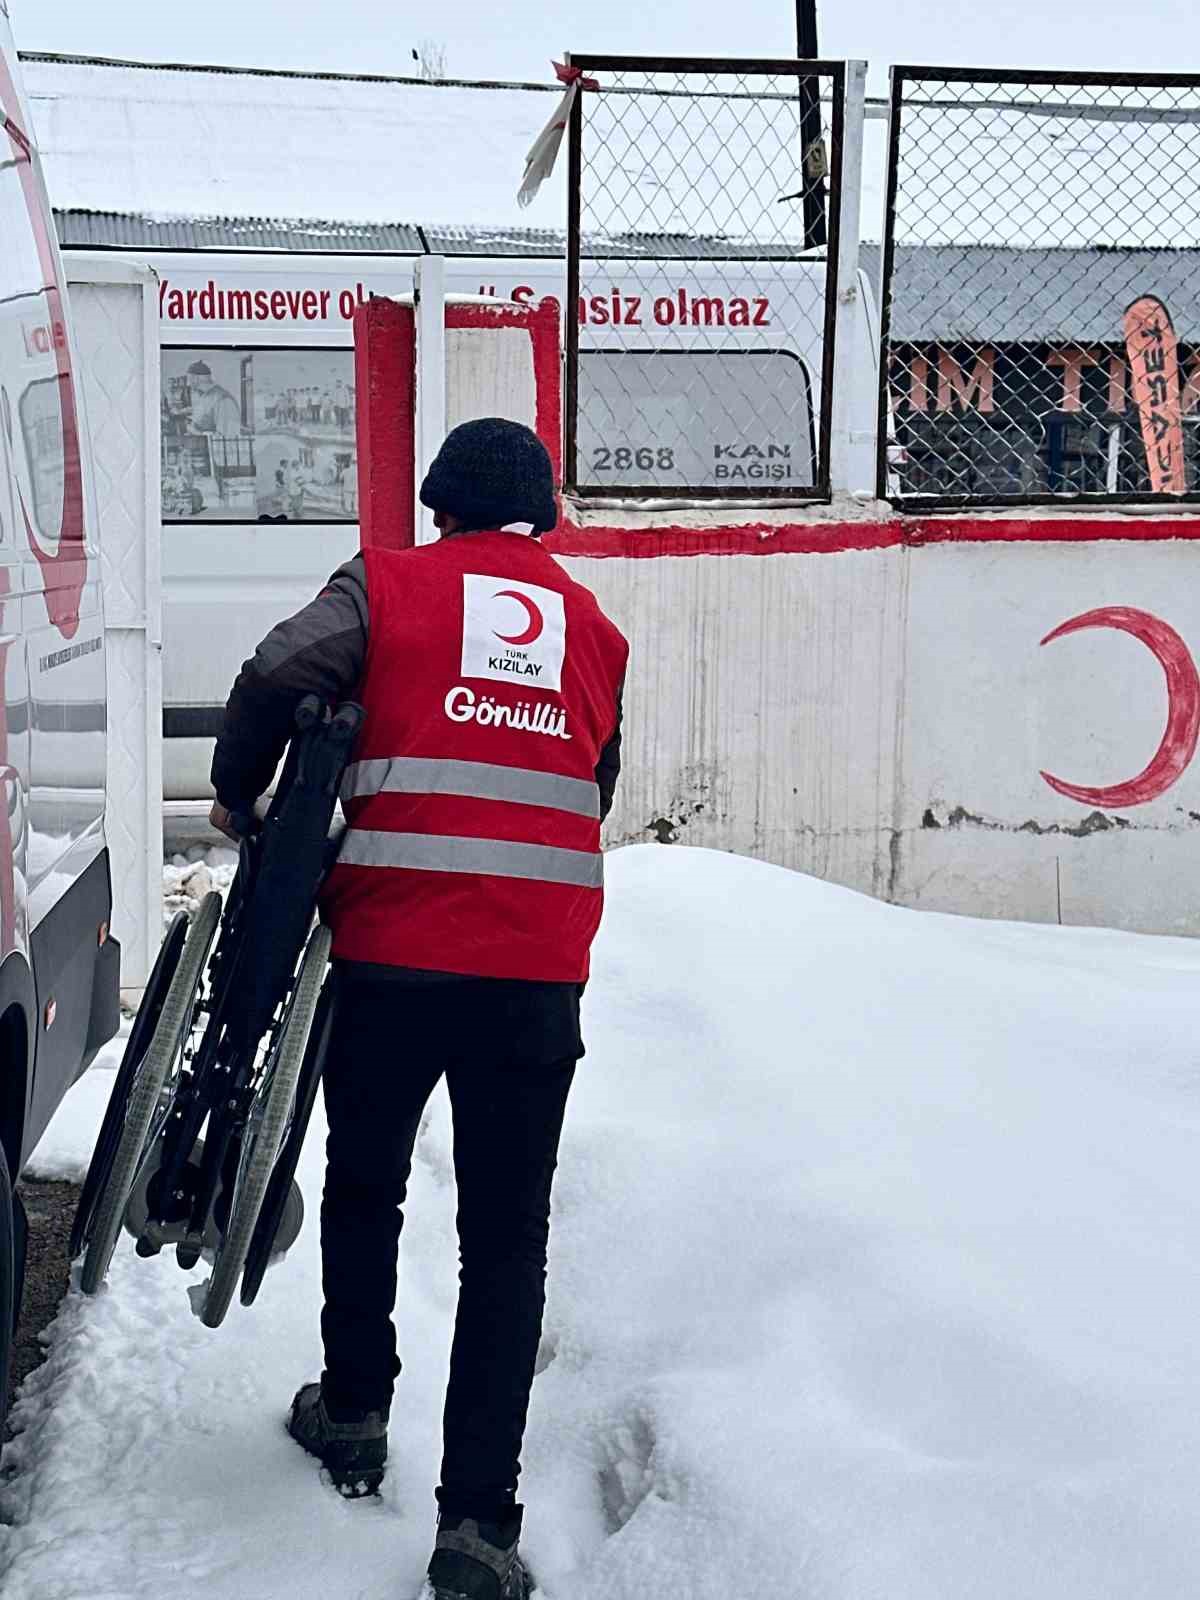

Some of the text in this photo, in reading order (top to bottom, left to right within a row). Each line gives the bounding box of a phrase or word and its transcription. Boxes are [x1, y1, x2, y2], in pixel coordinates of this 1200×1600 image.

[338, 282, 364, 320] ol
[653, 288, 770, 326] olmaz
[592, 447, 675, 471] 2868
[713, 444, 792, 459] KAN
[488, 656, 543, 676] KIZILAY
[444, 686, 572, 739] Gönüllü
